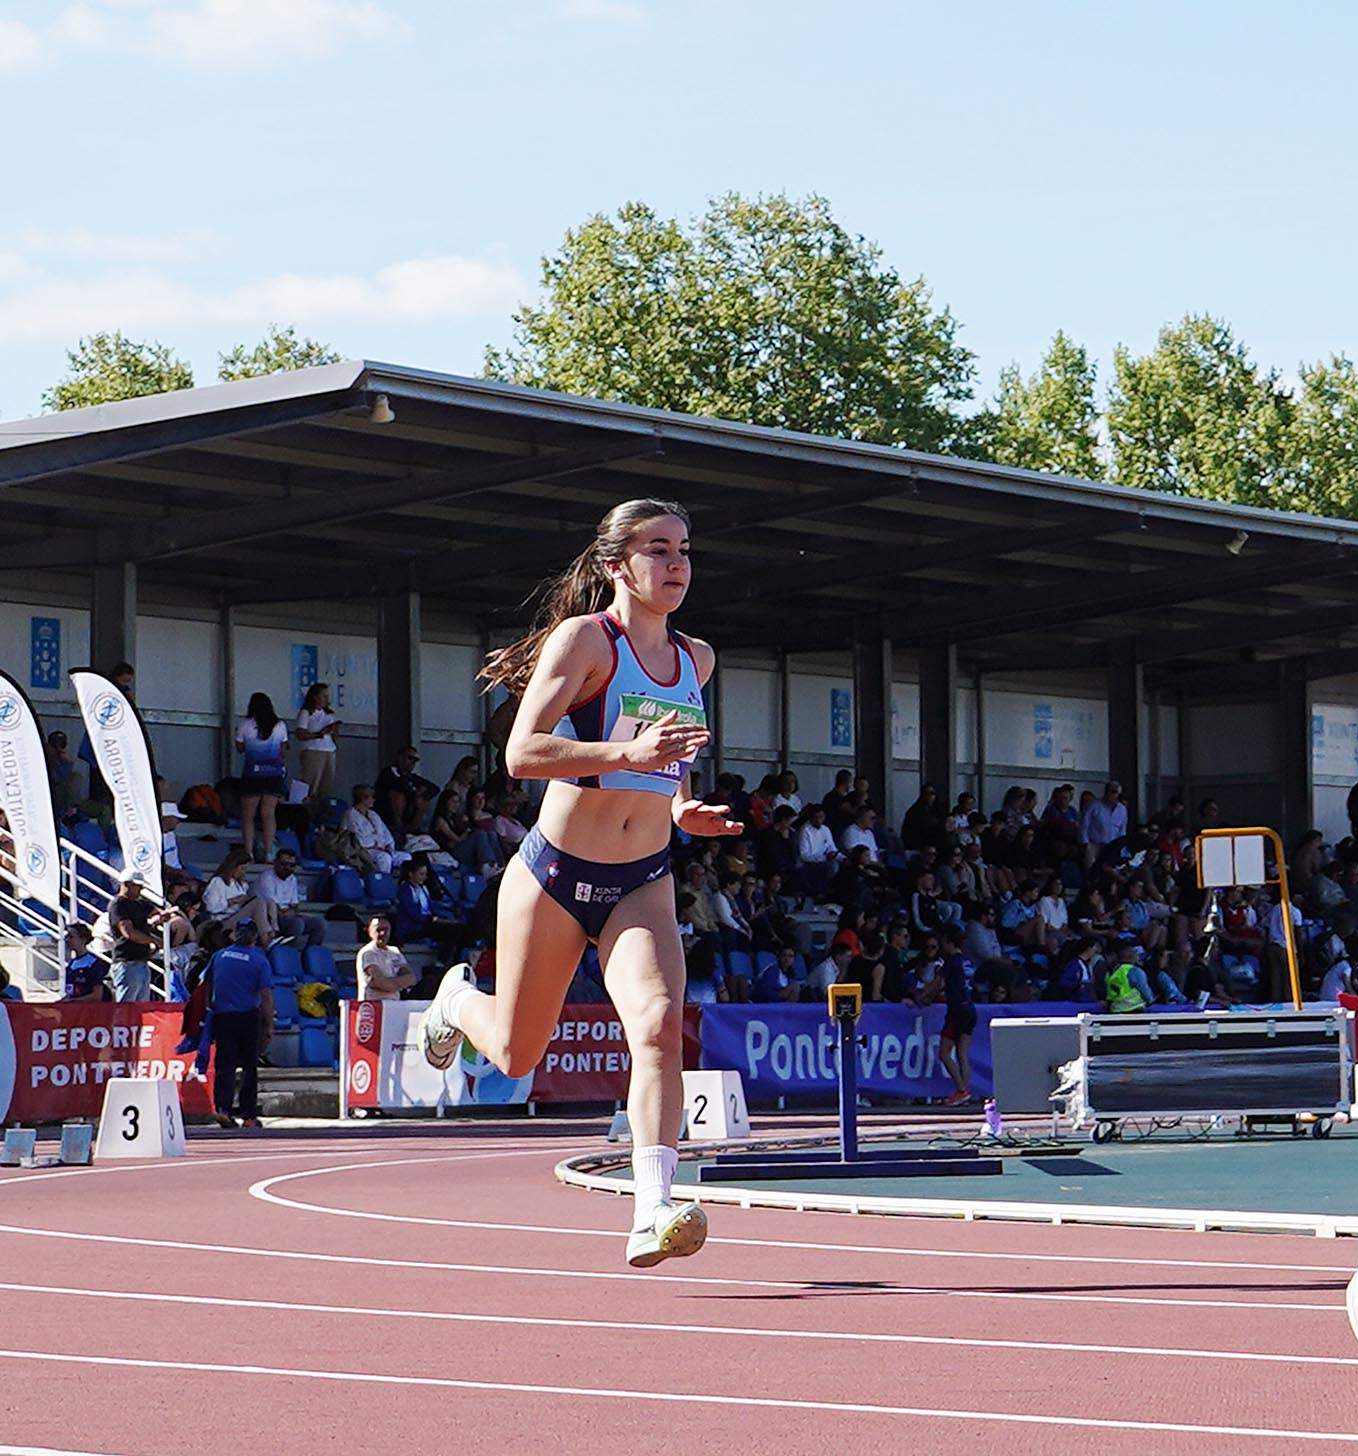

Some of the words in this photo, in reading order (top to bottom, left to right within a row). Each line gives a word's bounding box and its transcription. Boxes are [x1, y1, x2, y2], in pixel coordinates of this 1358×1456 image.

[31, 1025, 156, 1052] DEPORTE
[122, 1105, 140, 1142] 3
[166, 1105, 176, 1141] 3
[693, 1094, 708, 1125] 2
[729, 1093, 740, 1124] 2
